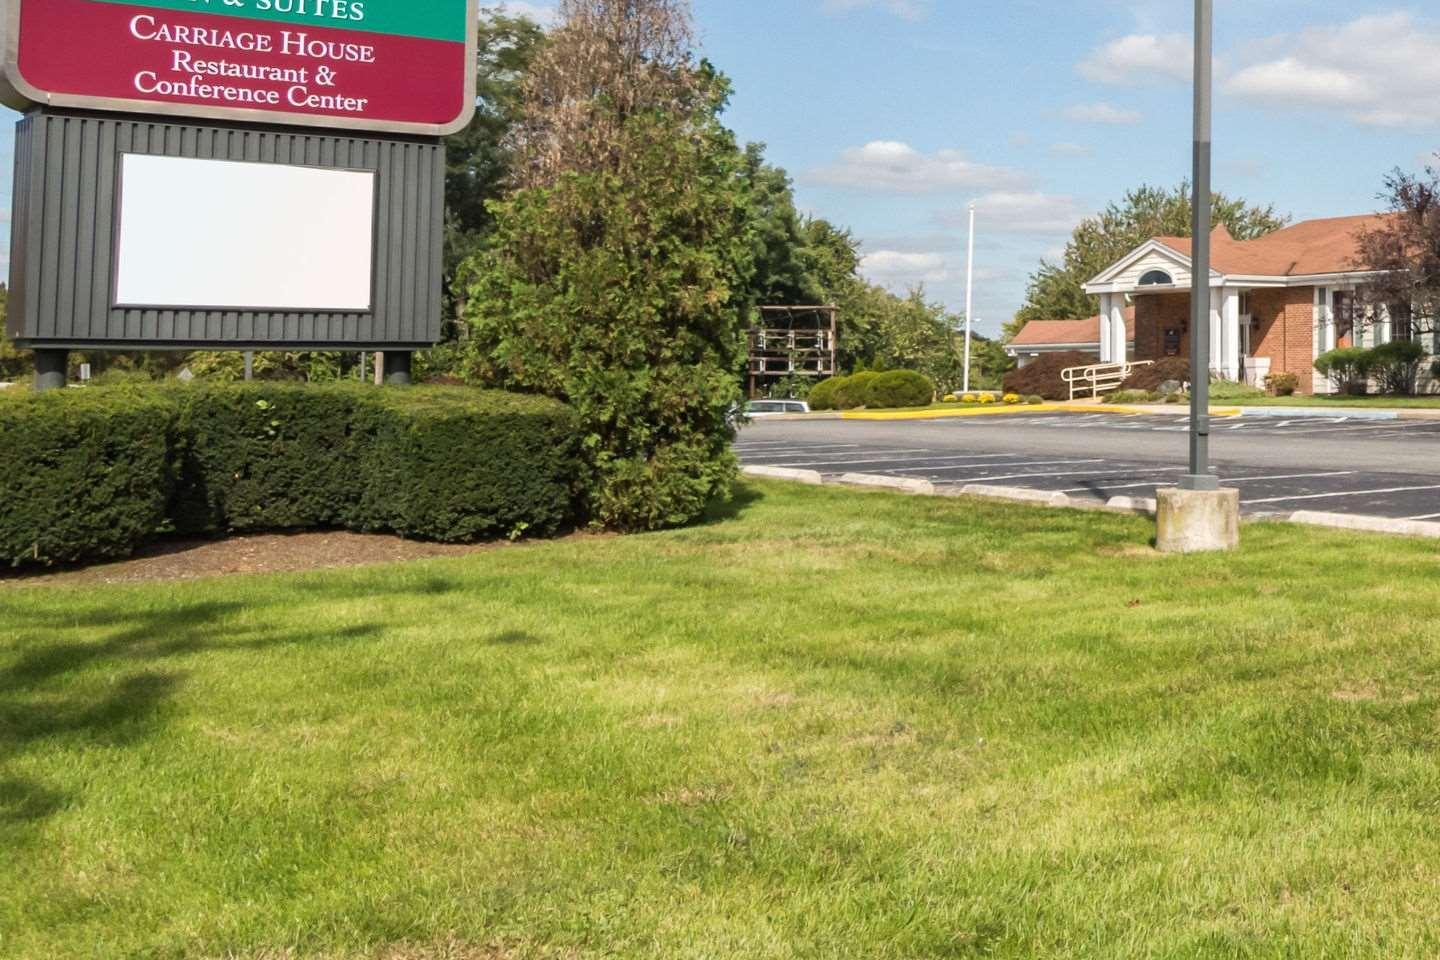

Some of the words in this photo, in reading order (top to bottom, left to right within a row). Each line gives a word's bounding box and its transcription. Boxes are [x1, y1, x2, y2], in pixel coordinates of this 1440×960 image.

[129, 14, 273, 53] CARRIAGE
[279, 30, 376, 64] HOUSE
[171, 49, 309, 84] Restaurant
[314, 65, 336, 86] &
[133, 70, 280, 104] Conference
[287, 85, 368, 112] Center
